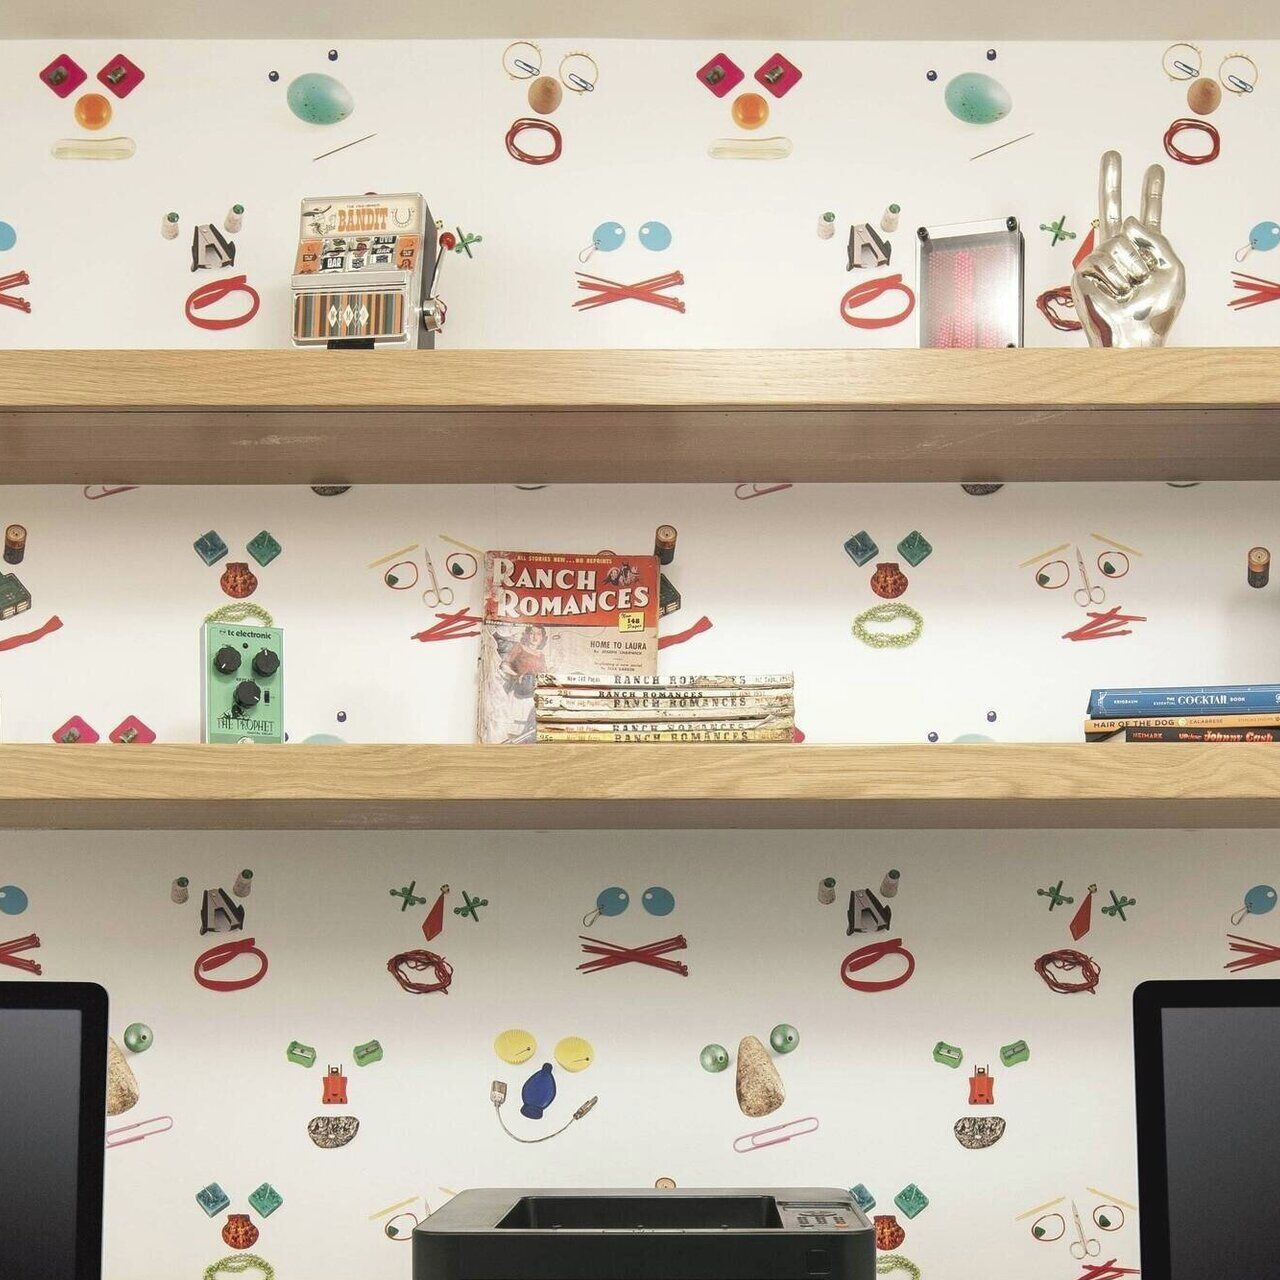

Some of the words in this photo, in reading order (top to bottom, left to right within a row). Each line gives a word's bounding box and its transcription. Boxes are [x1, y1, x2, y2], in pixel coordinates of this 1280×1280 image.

[338, 208, 388, 232] BANDIT
[493, 558, 596, 591] RANCH
[496, 586, 649, 618] ROMANCES
[236, 630, 272, 639] electronic
[626, 642, 646, 650] LAURA
[614, 676, 660, 684] RANCH
[614, 700, 660, 708] RANCH
[670, 698, 746, 708] ROMANCES
[1178, 695, 1227, 705] COCKTAIL
[218, 717, 233, 730] THE
[236, 718, 273, 731] PROPHET
[615, 734, 660, 742] RANCH
[672, 732, 748, 742] ROMANCES
[1204, 731, 1243, 742] Johnny
[1246, 732, 1273, 742] Cash
